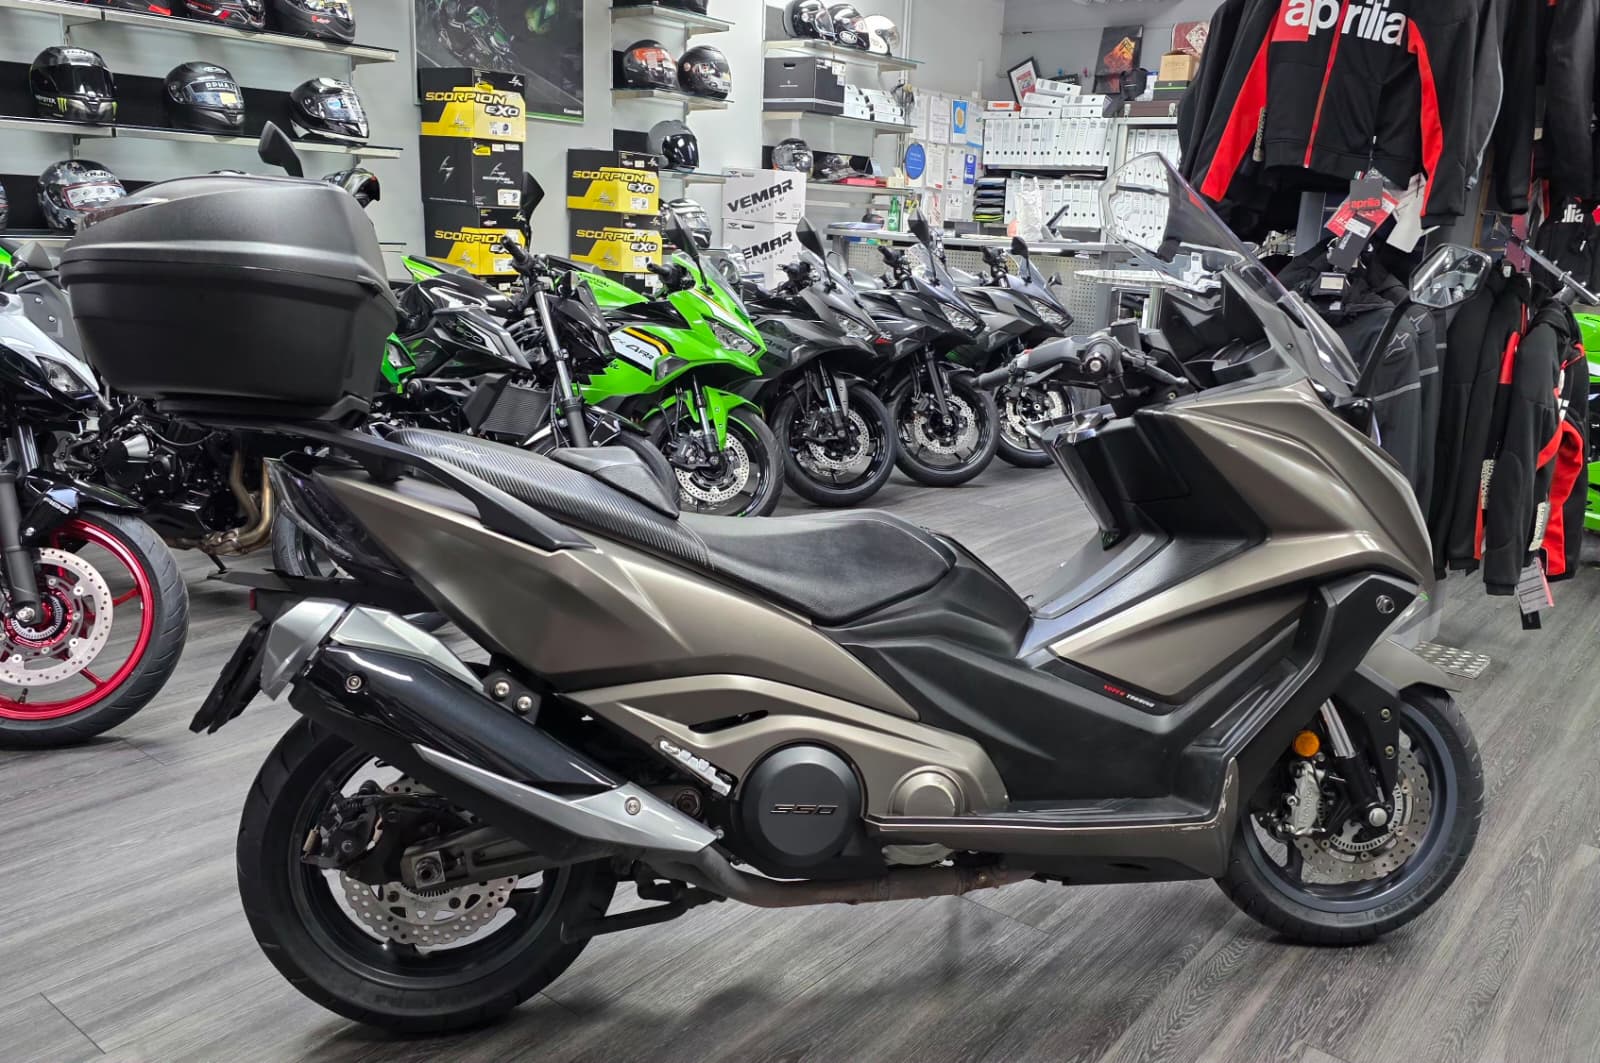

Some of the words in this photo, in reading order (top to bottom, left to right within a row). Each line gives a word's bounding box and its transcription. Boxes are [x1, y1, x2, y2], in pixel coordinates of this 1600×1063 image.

[1285, 0, 1407, 46] aprilia
[425, 91, 506, 106] SCORPION
[572, 170, 645, 182] SCORPION
[727, 179, 794, 213] VEMAR
[576, 229, 648, 242] SCORPION
[742, 231, 793, 260] EMAR
[750, 249, 785, 265] ELMETS
